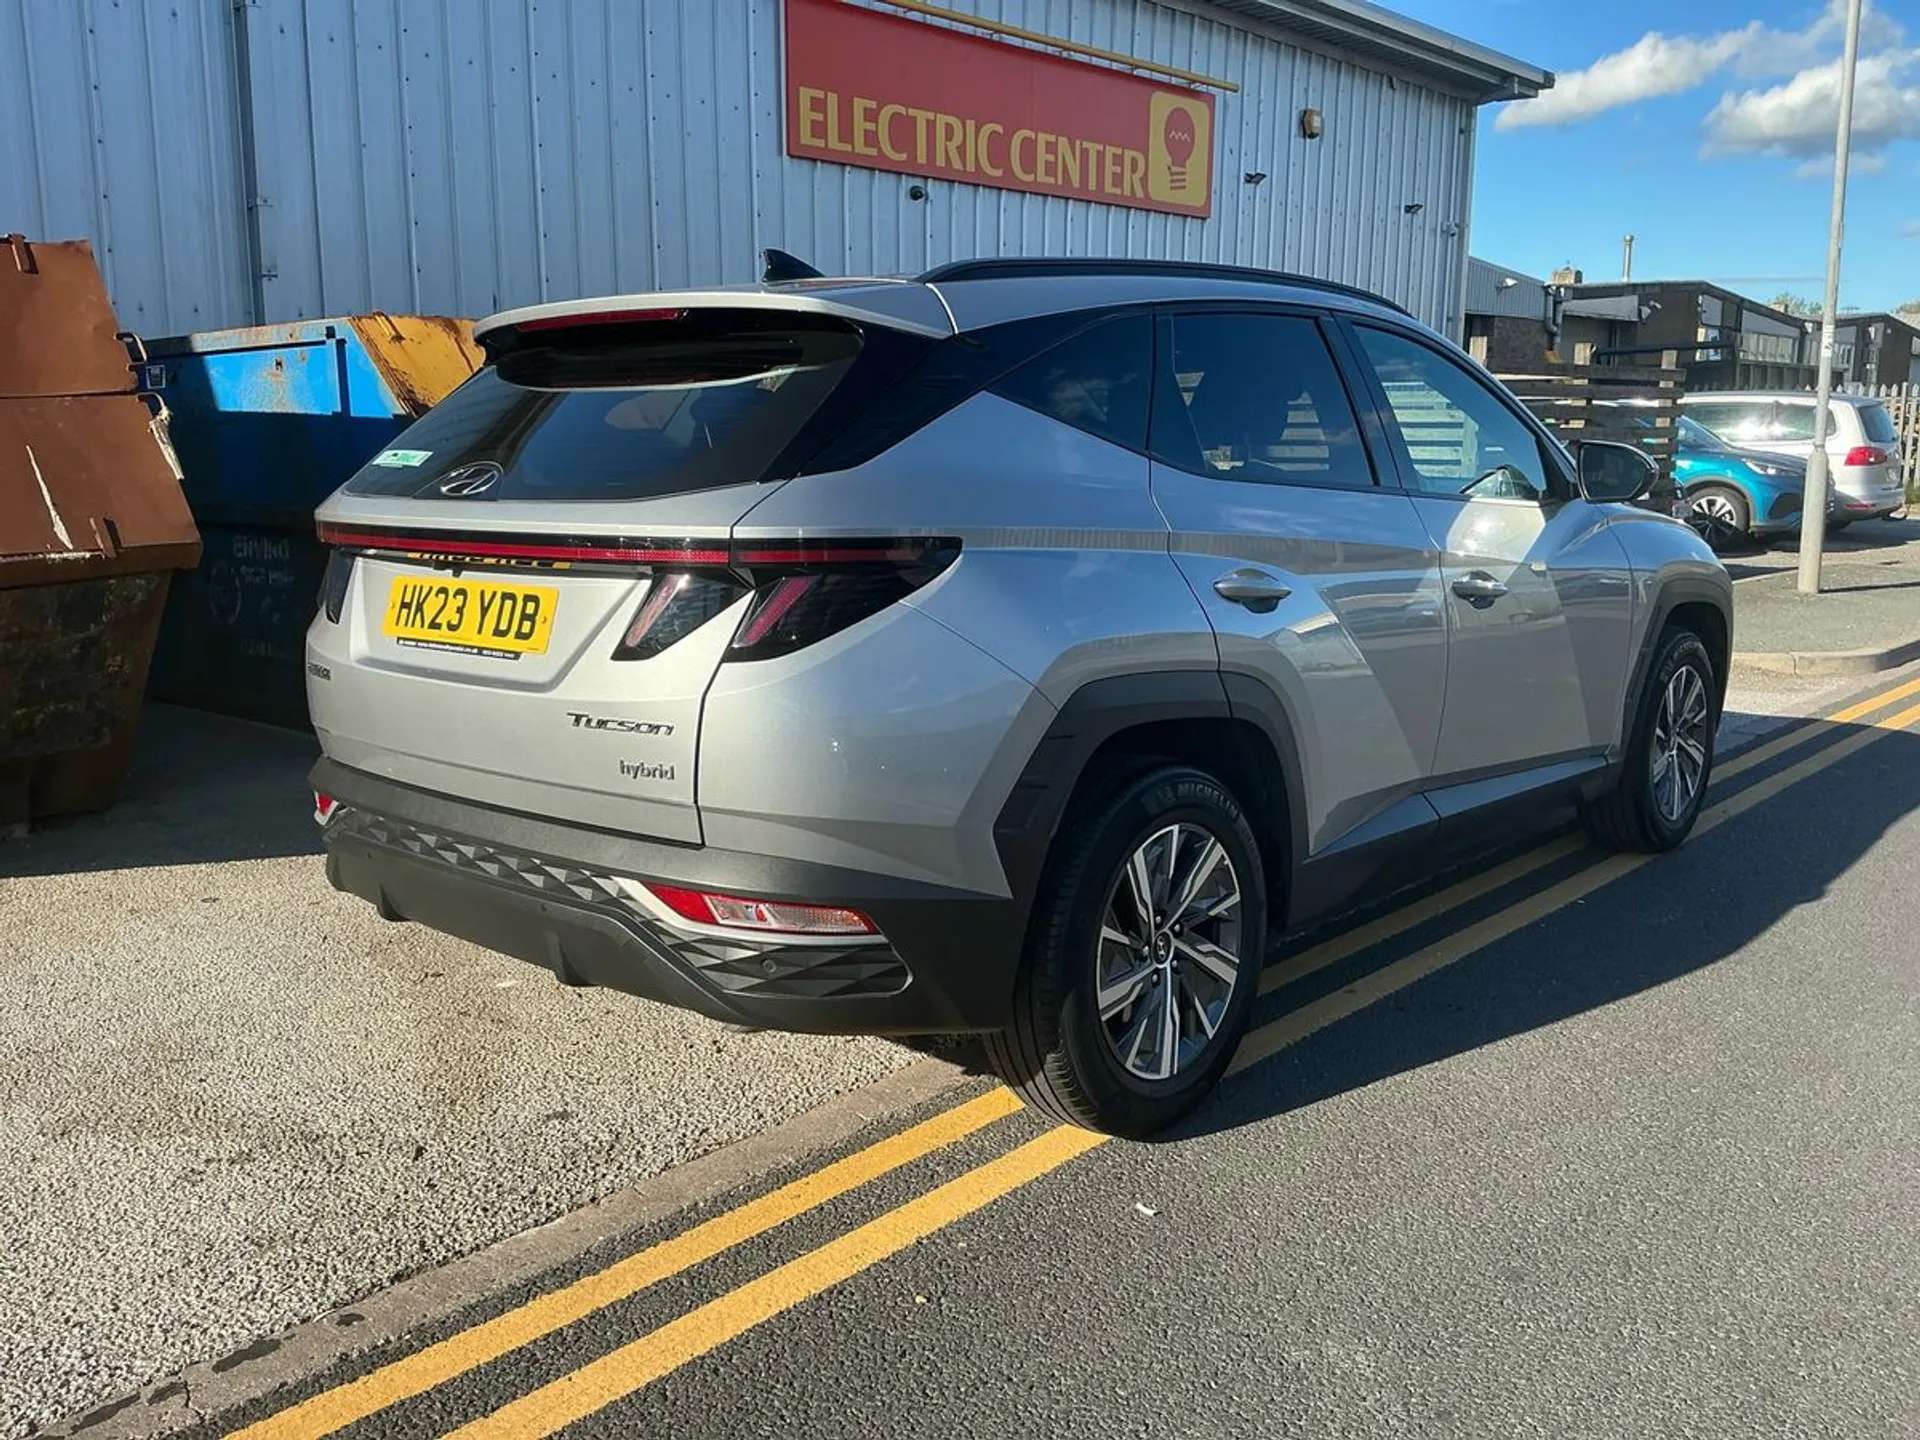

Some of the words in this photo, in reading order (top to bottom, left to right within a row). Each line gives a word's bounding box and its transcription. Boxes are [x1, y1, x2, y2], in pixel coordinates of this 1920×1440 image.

[799, 87, 1004, 176] ELECTRIC
[1010, 130, 1145, 198] CENTER
[395, 583, 469, 632] HK23
[475, 589, 541, 641] YDB
[619, 759, 674, 780] hybrid
